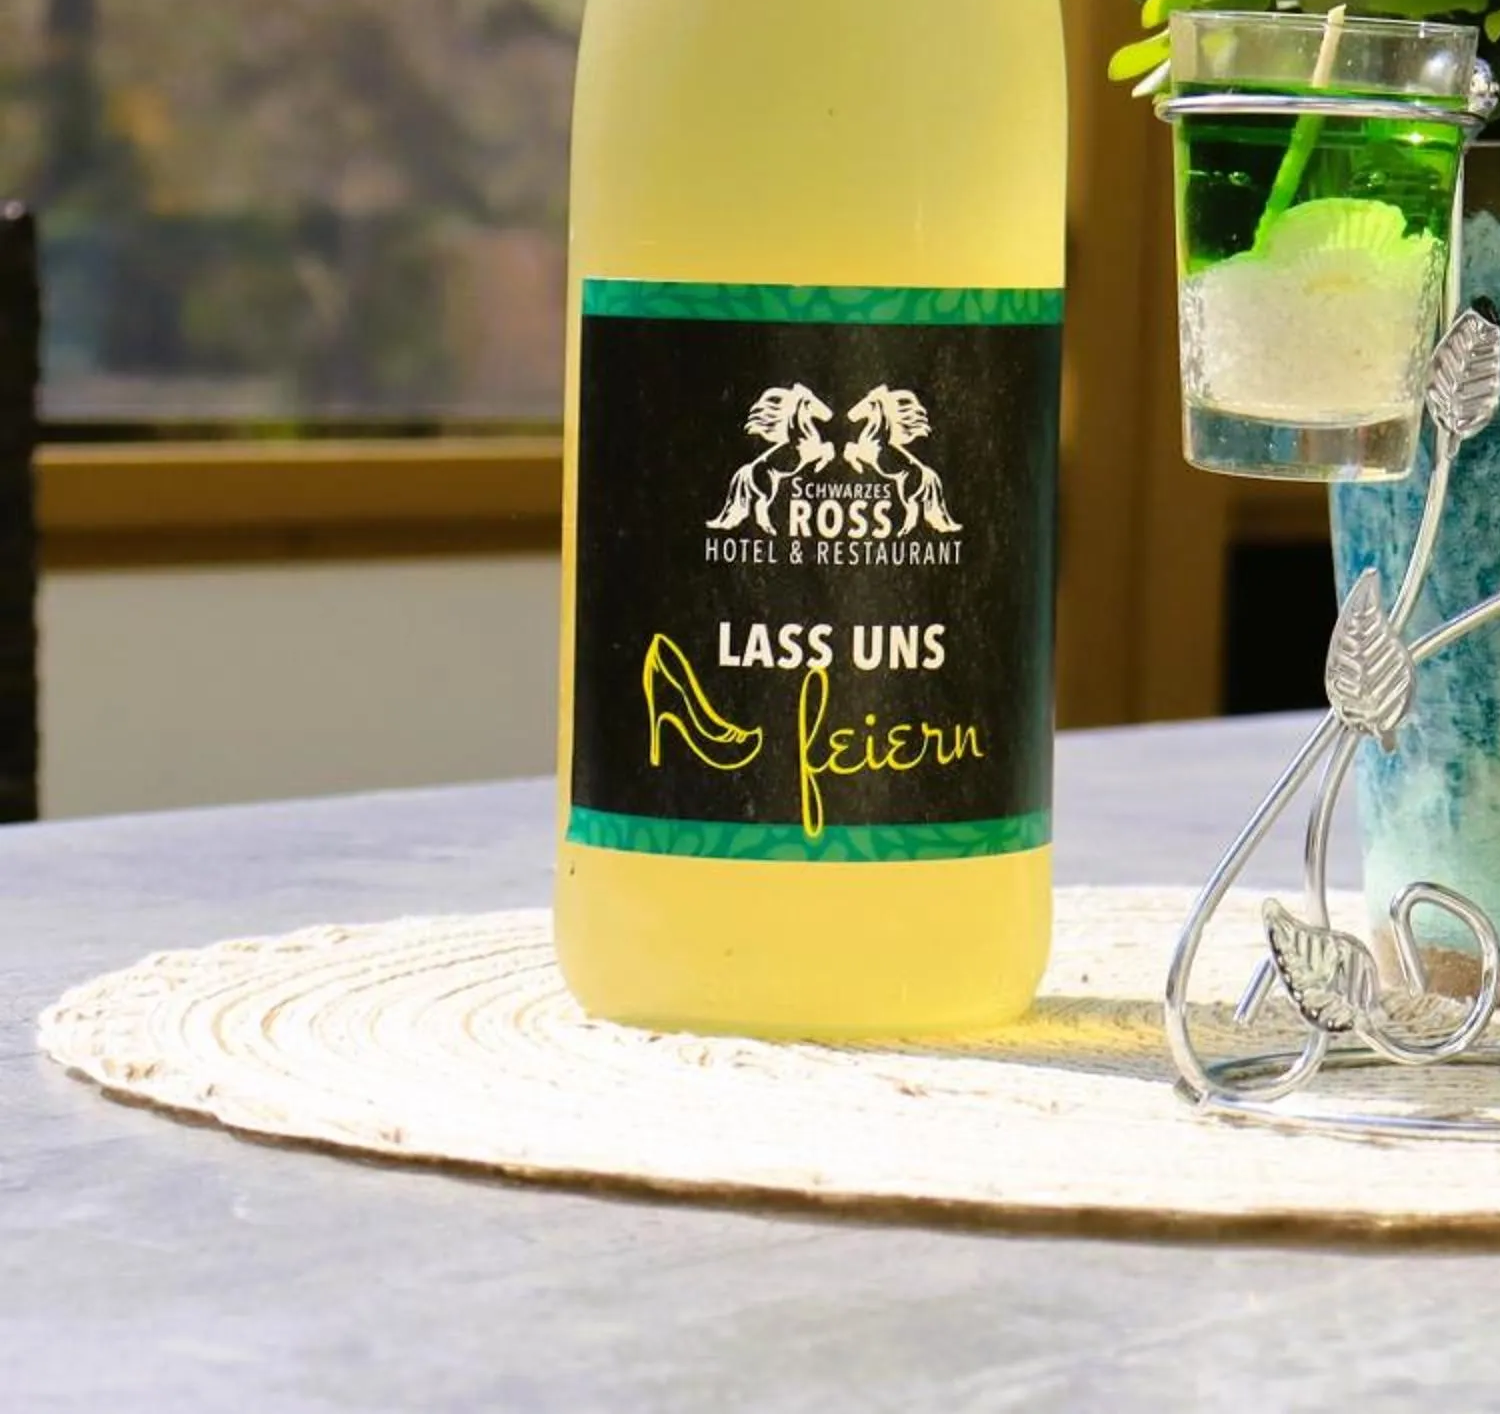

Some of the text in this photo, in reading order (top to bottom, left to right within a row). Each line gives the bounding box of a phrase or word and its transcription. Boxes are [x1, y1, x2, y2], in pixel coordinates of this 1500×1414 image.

[790, 476, 892, 500] SCHWARZES
[788, 500, 892, 538] ROSS
[705, 537, 963, 565] HOTEL & RESTAURANT
[718, 621, 945, 670] LASS UNS
[798, 668, 984, 837] feiern
